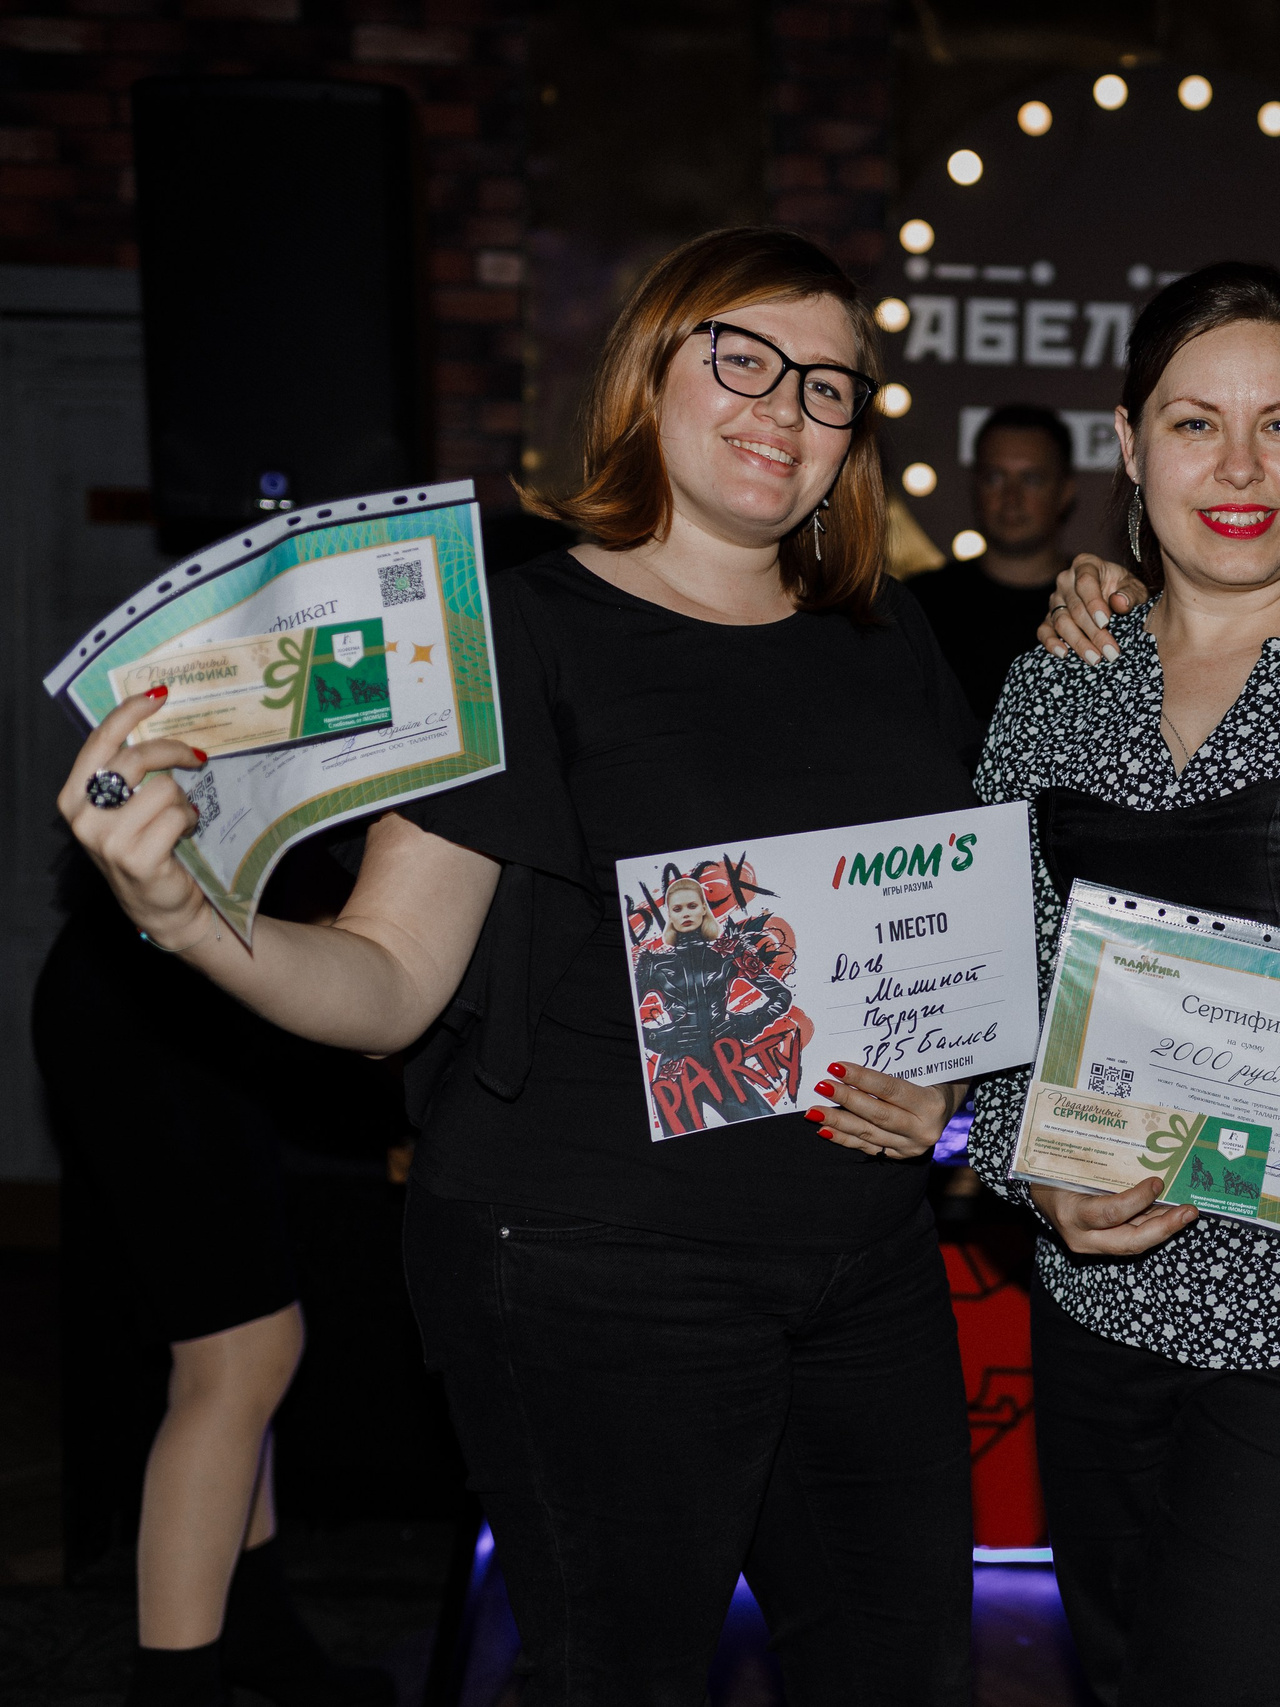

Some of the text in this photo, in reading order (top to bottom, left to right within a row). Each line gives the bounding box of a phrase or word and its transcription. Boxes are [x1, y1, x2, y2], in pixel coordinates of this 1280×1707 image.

[882, 880, 934, 897] ИГРЫ РАЗУМА
[874, 911, 949, 945] 1 МЕСТО
[1150, 1037, 1234, 1071] 2000
[1226, 1037, 1266, 1054] на сумму
[888, 1055, 974, 1080] IMOMS.MYTISHCHI
[652, 1025, 802, 1138] PARTY
[1053, 1106, 1128, 1130] СЕРТИФИКАТ
